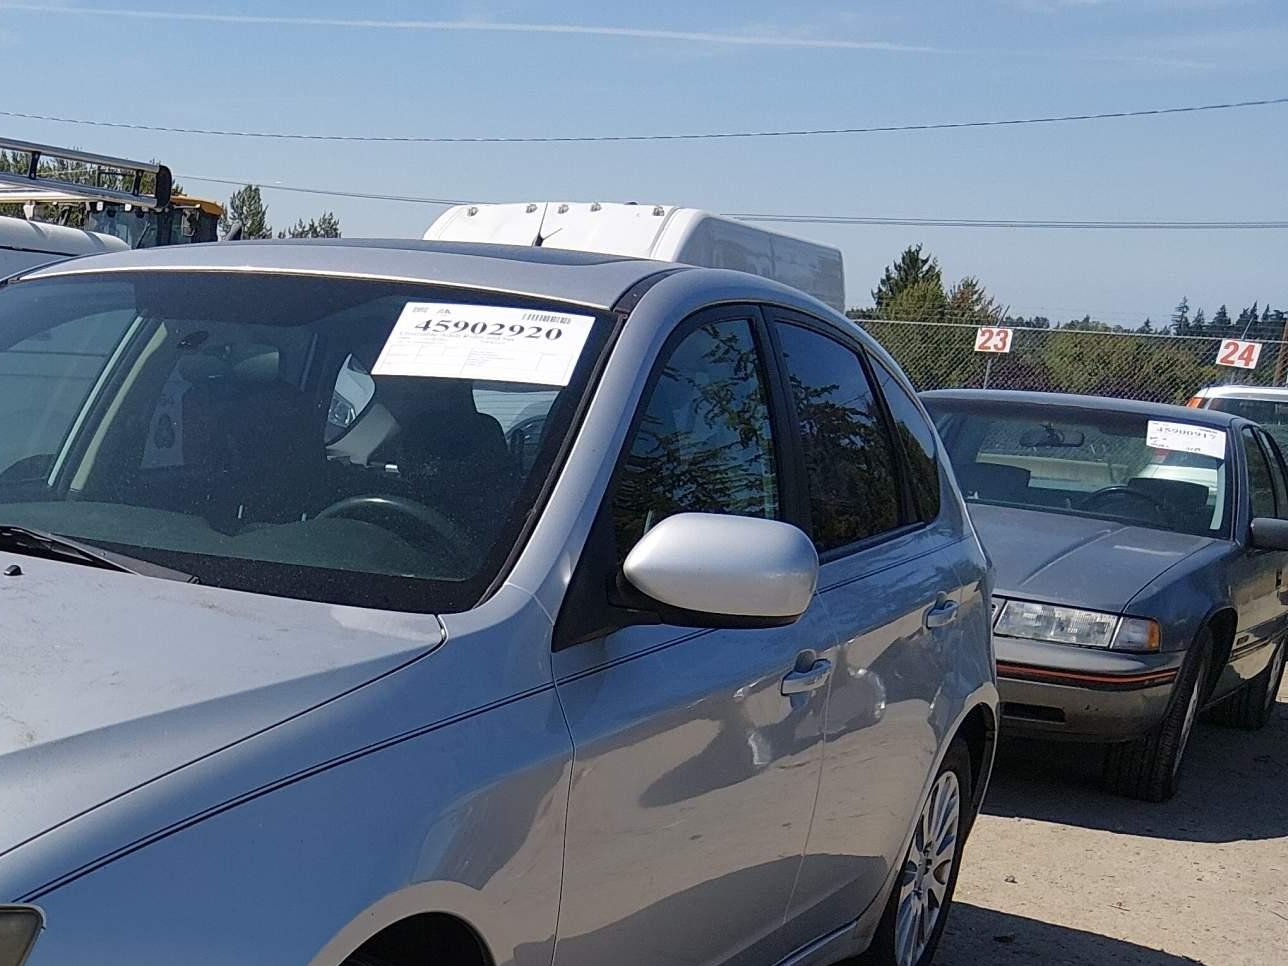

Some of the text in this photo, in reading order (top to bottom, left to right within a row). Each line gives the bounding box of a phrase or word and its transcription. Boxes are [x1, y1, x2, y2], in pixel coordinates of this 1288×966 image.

[414, 319, 563, 341] 45902920
[977, 329, 1009, 352] 23
[1219, 341, 1255, 367] 24
